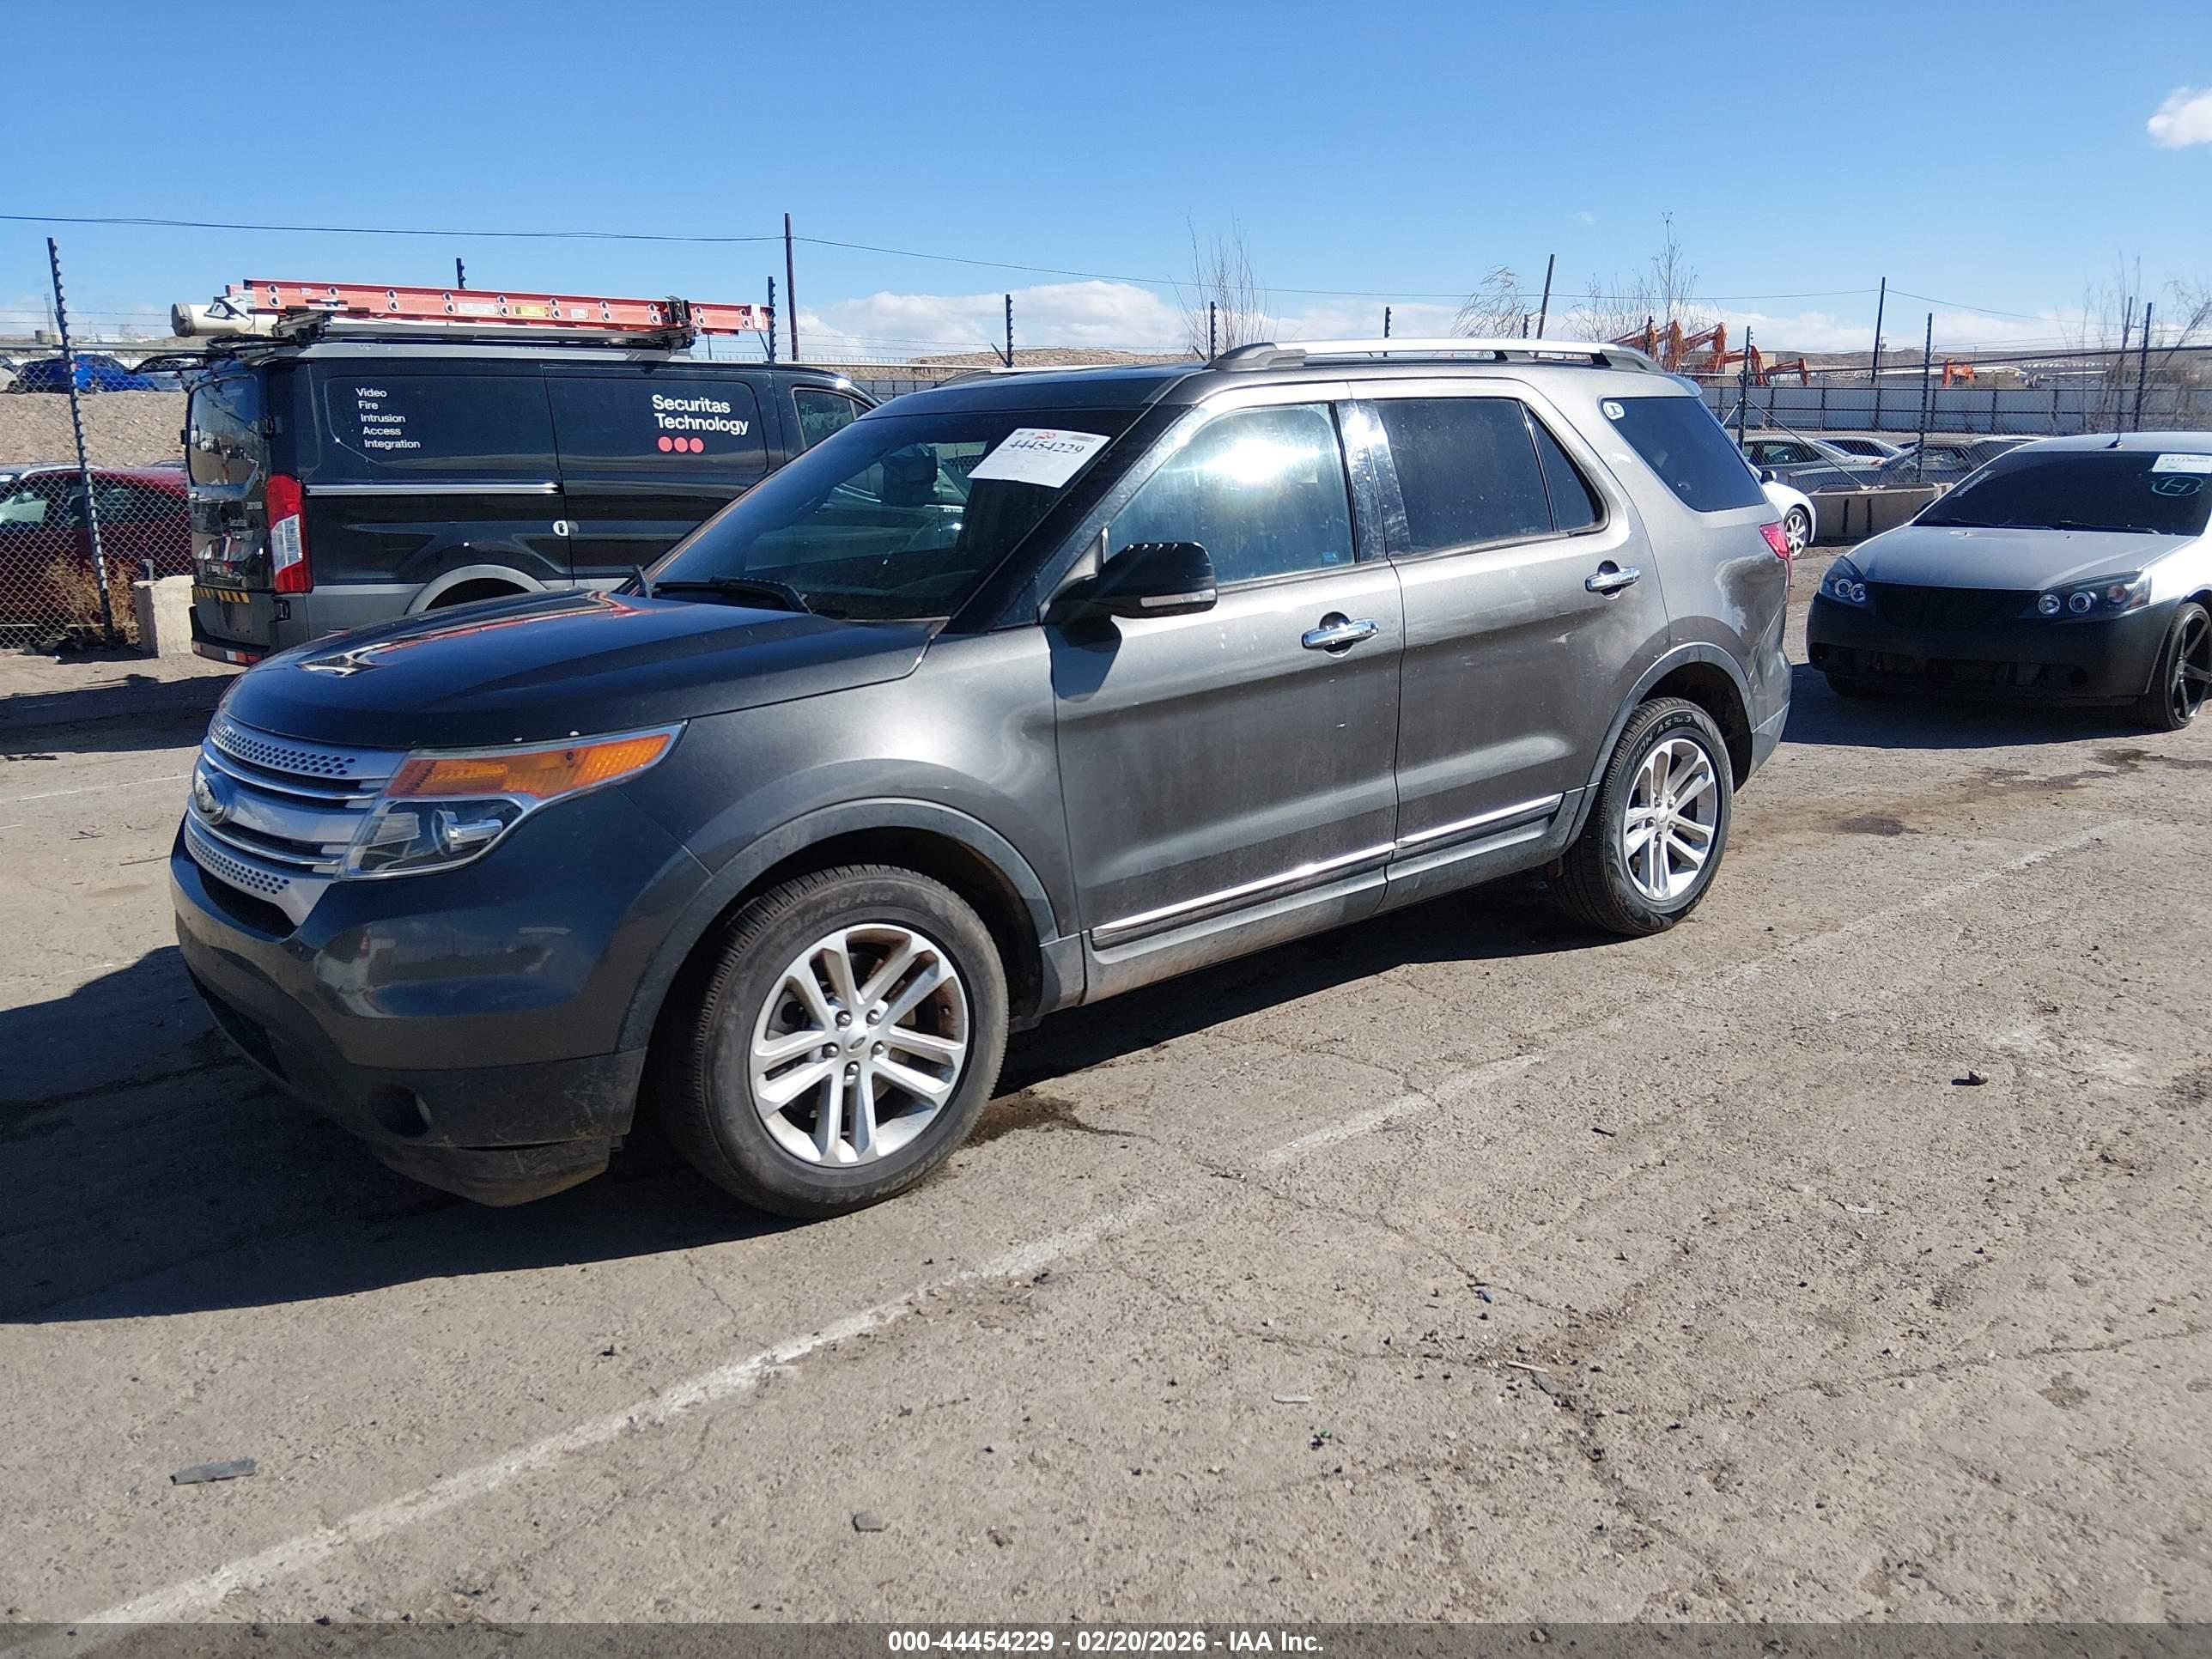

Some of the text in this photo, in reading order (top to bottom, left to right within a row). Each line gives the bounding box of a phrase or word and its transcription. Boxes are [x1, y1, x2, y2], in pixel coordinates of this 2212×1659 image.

[356, 387, 387, 398] Video
[358, 400, 379, 410] Fire
[652, 395, 731, 414] Securitas
[361, 413, 406, 424] Intrusion
[654, 413, 750, 436] Technology
[362, 426, 402, 436] Access
[364, 439, 421, 451] Integration
[1009, 439, 1086, 455] 44454229
[1656, 719, 1673, 734] AS
